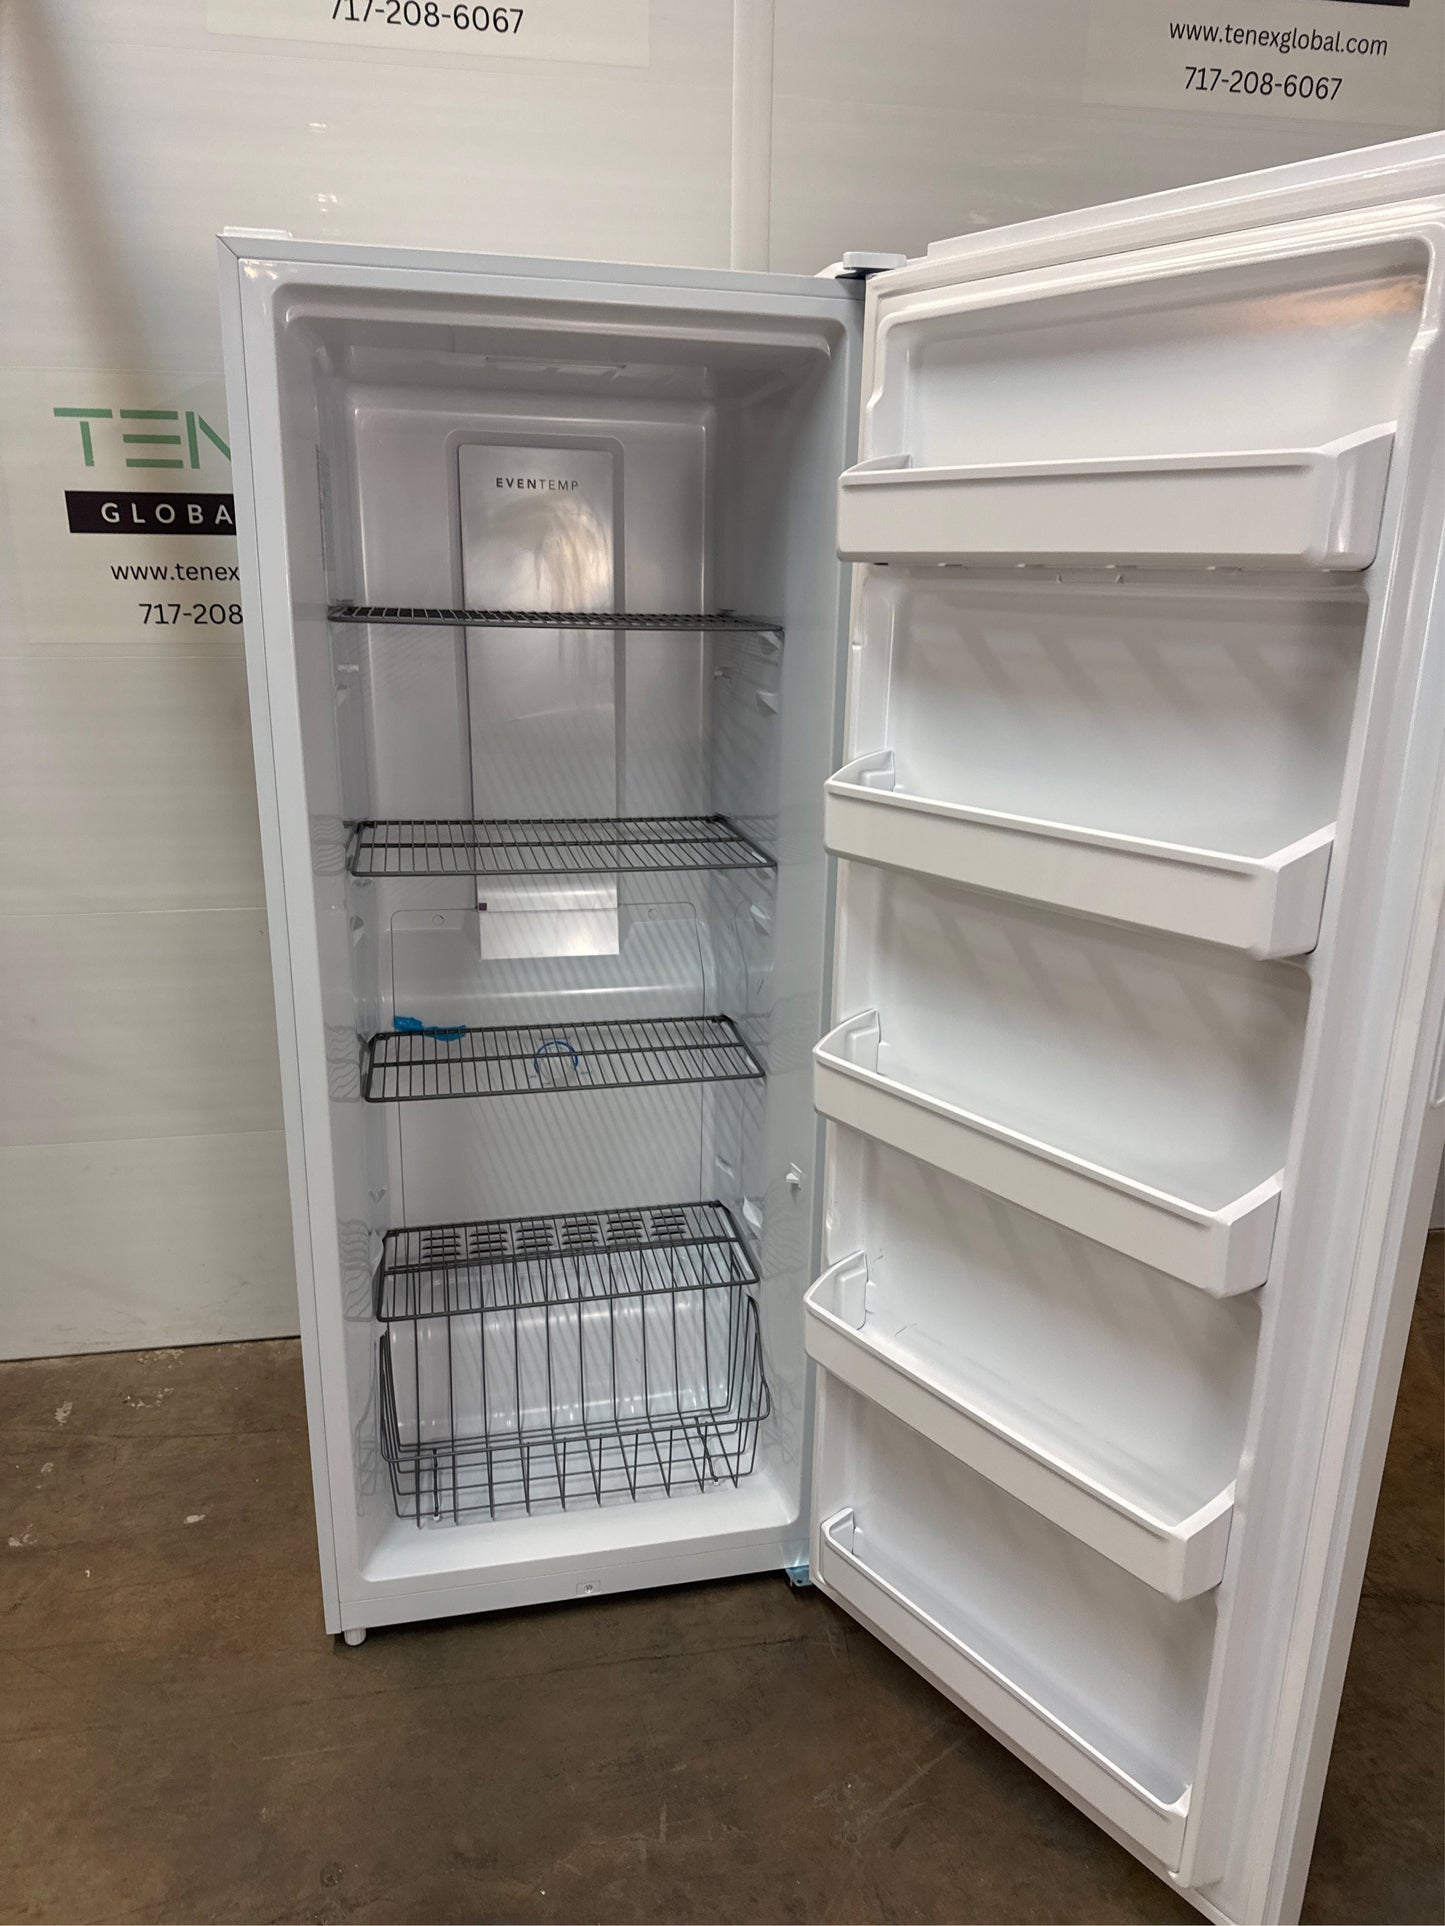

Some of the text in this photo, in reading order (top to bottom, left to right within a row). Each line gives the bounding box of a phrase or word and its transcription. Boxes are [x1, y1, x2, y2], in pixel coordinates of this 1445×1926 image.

[1169, 21, 1389, 56] www.tenexglobal.com
[1184, 65, 1343, 101] 717-208-6067
[495, 477, 579, 492] EVENTEMP
